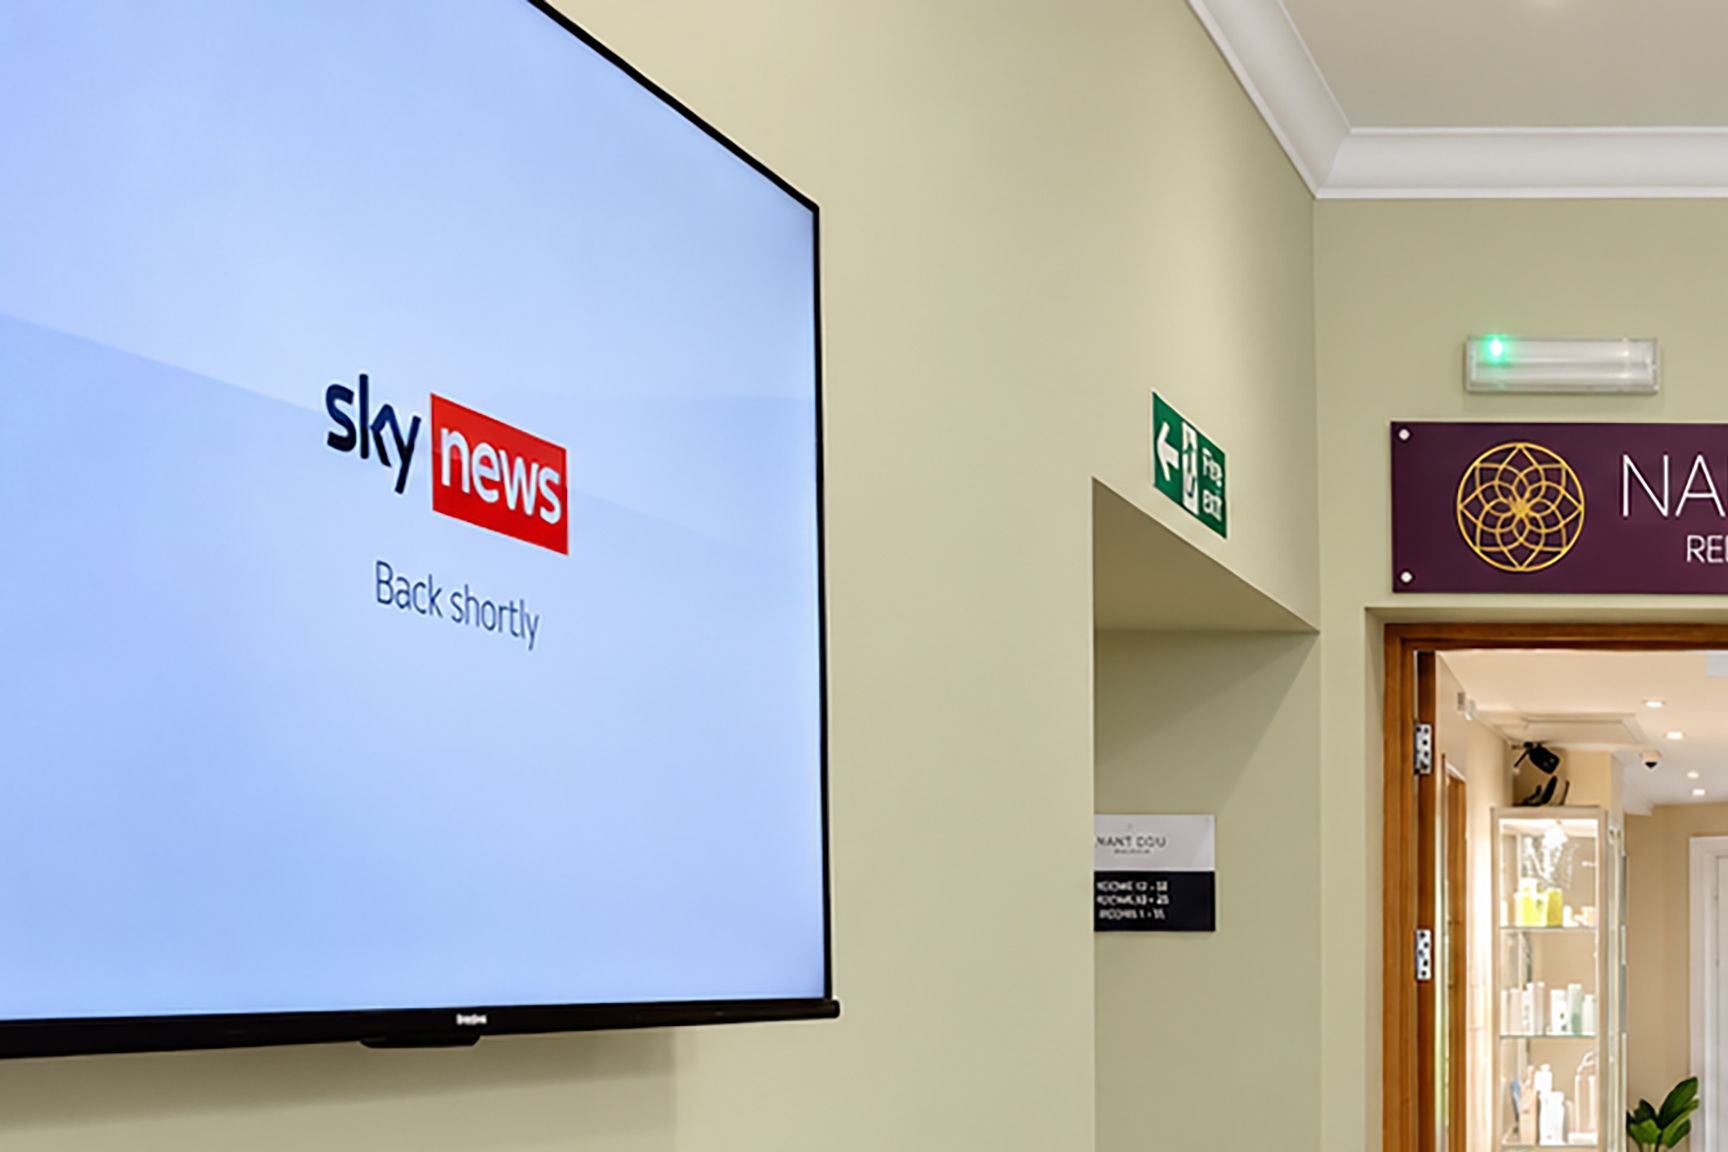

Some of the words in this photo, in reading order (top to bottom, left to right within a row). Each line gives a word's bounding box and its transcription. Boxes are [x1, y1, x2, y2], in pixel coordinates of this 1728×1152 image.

[325, 373, 422, 495] sky
[440, 427, 562, 525] news
[375, 560, 444, 619] Back
[449, 583, 540, 651] shortly
[1096, 836, 1132, 847] NANT
